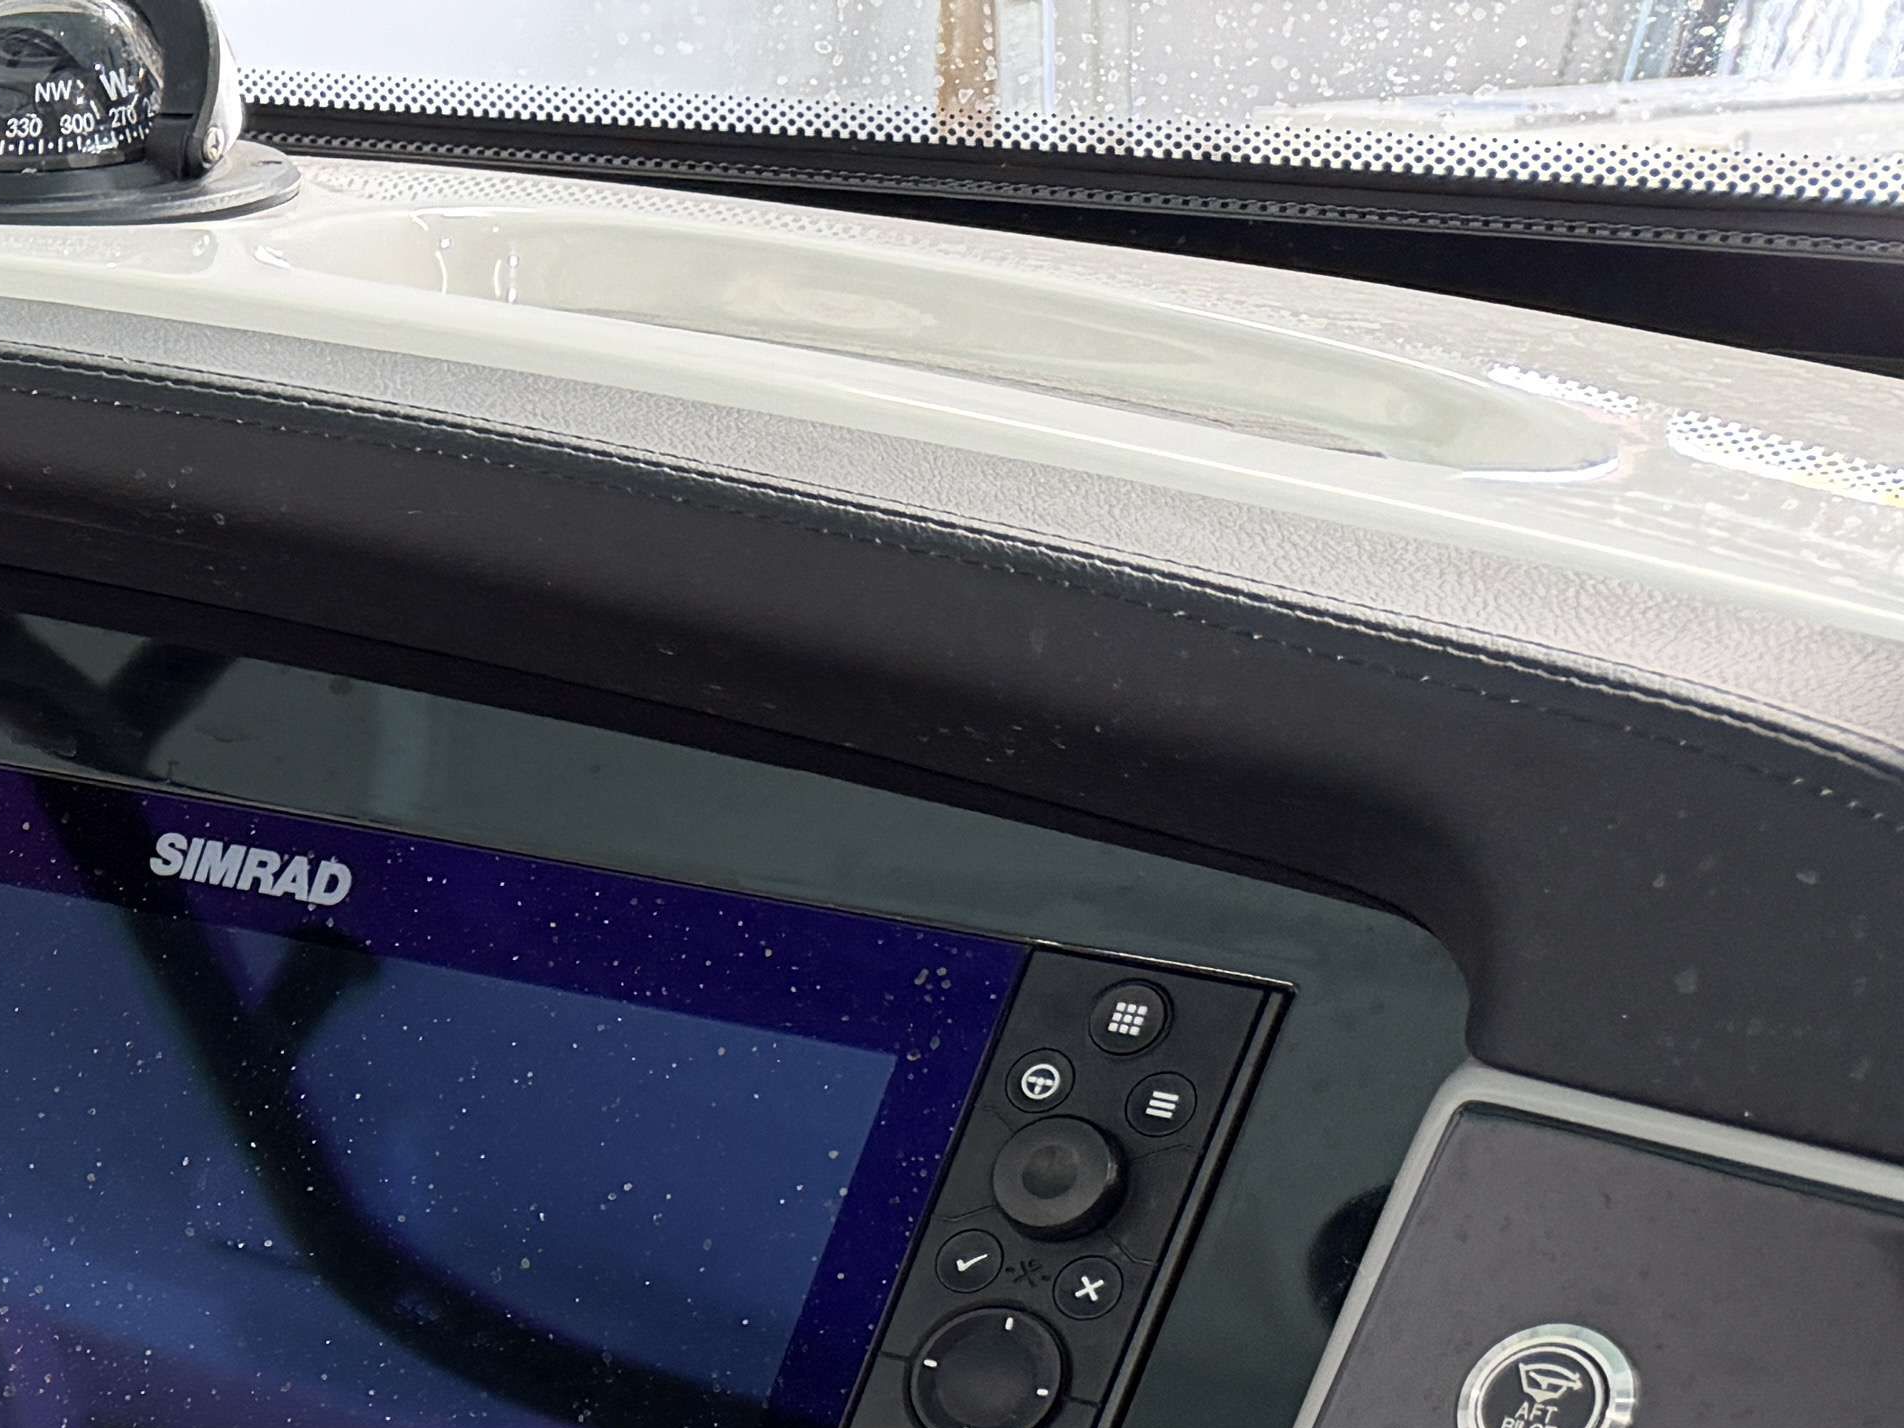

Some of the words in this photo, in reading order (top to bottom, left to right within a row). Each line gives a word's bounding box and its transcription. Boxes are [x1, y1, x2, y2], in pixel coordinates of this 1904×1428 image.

[35, 79, 72, 102] NW
[99, 67, 128, 101] W
[5, 115, 43, 138] 330
[60, 112, 95, 135] 300
[109, 104, 137, 128] 270
[149, 832, 352, 906] SIMRAD
[1514, 1401, 1559, 1425] AFT
